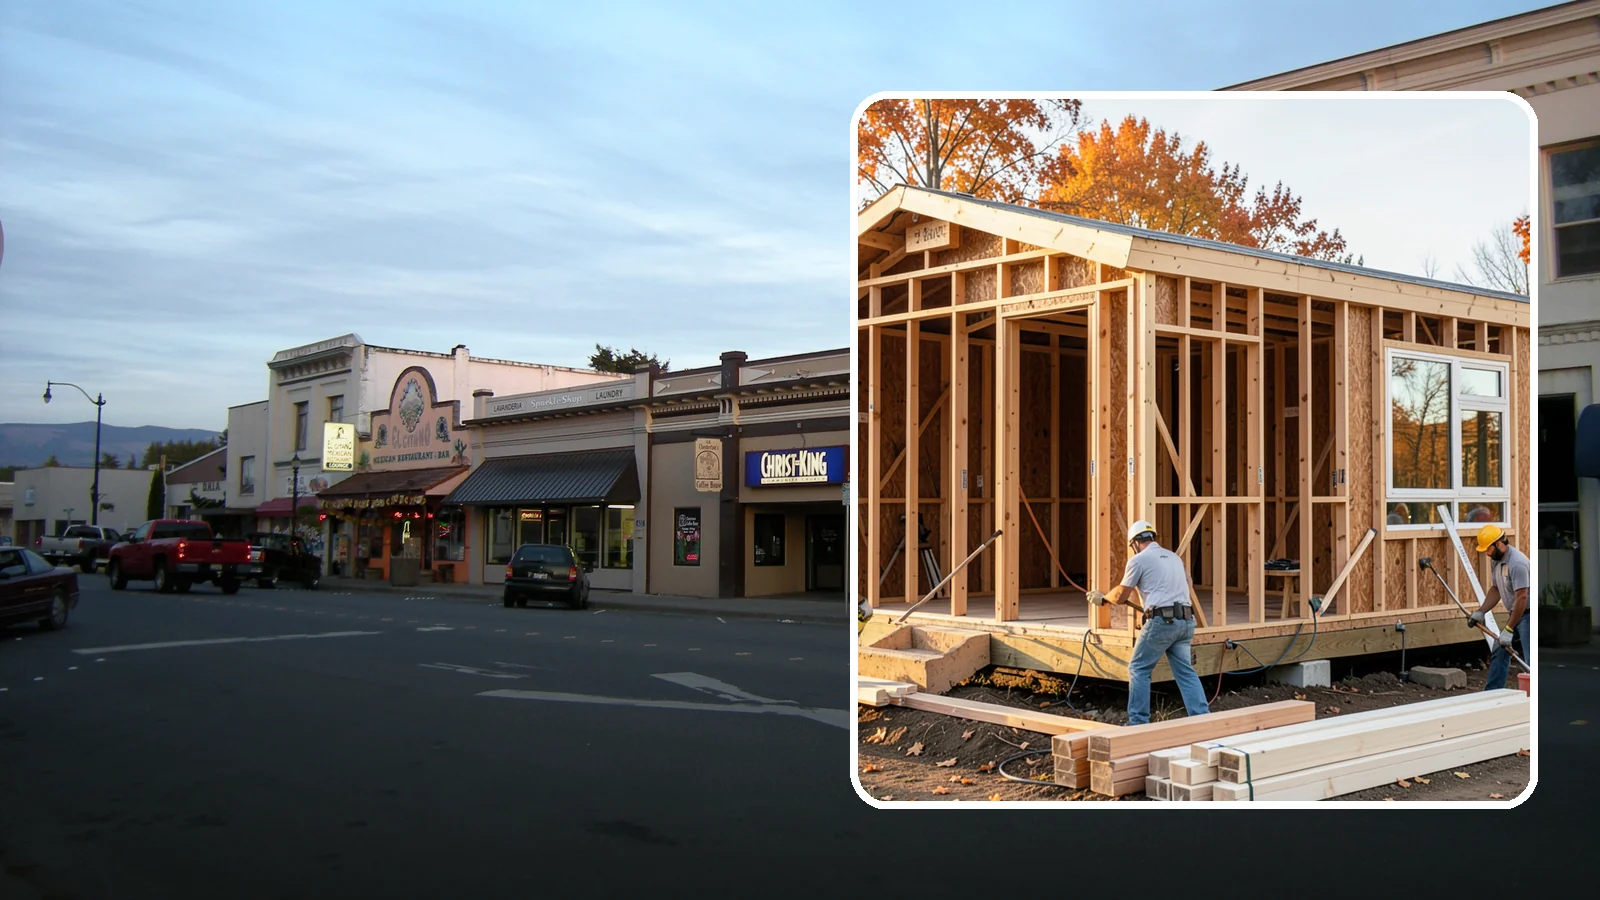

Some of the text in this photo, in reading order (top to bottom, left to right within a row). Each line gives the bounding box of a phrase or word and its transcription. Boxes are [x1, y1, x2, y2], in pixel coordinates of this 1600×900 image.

[561, 394, 582, 404] Shop
[595, 389, 623, 400] LAUNDRY
[493, 402, 522, 412] LAVANDERIA
[374, 454, 396, 464] MEXICAN
[397, 451, 433, 462] RESTAURANT
[438, 450, 450, 459] BAR
[760, 450, 827, 478] CHRIST KING
